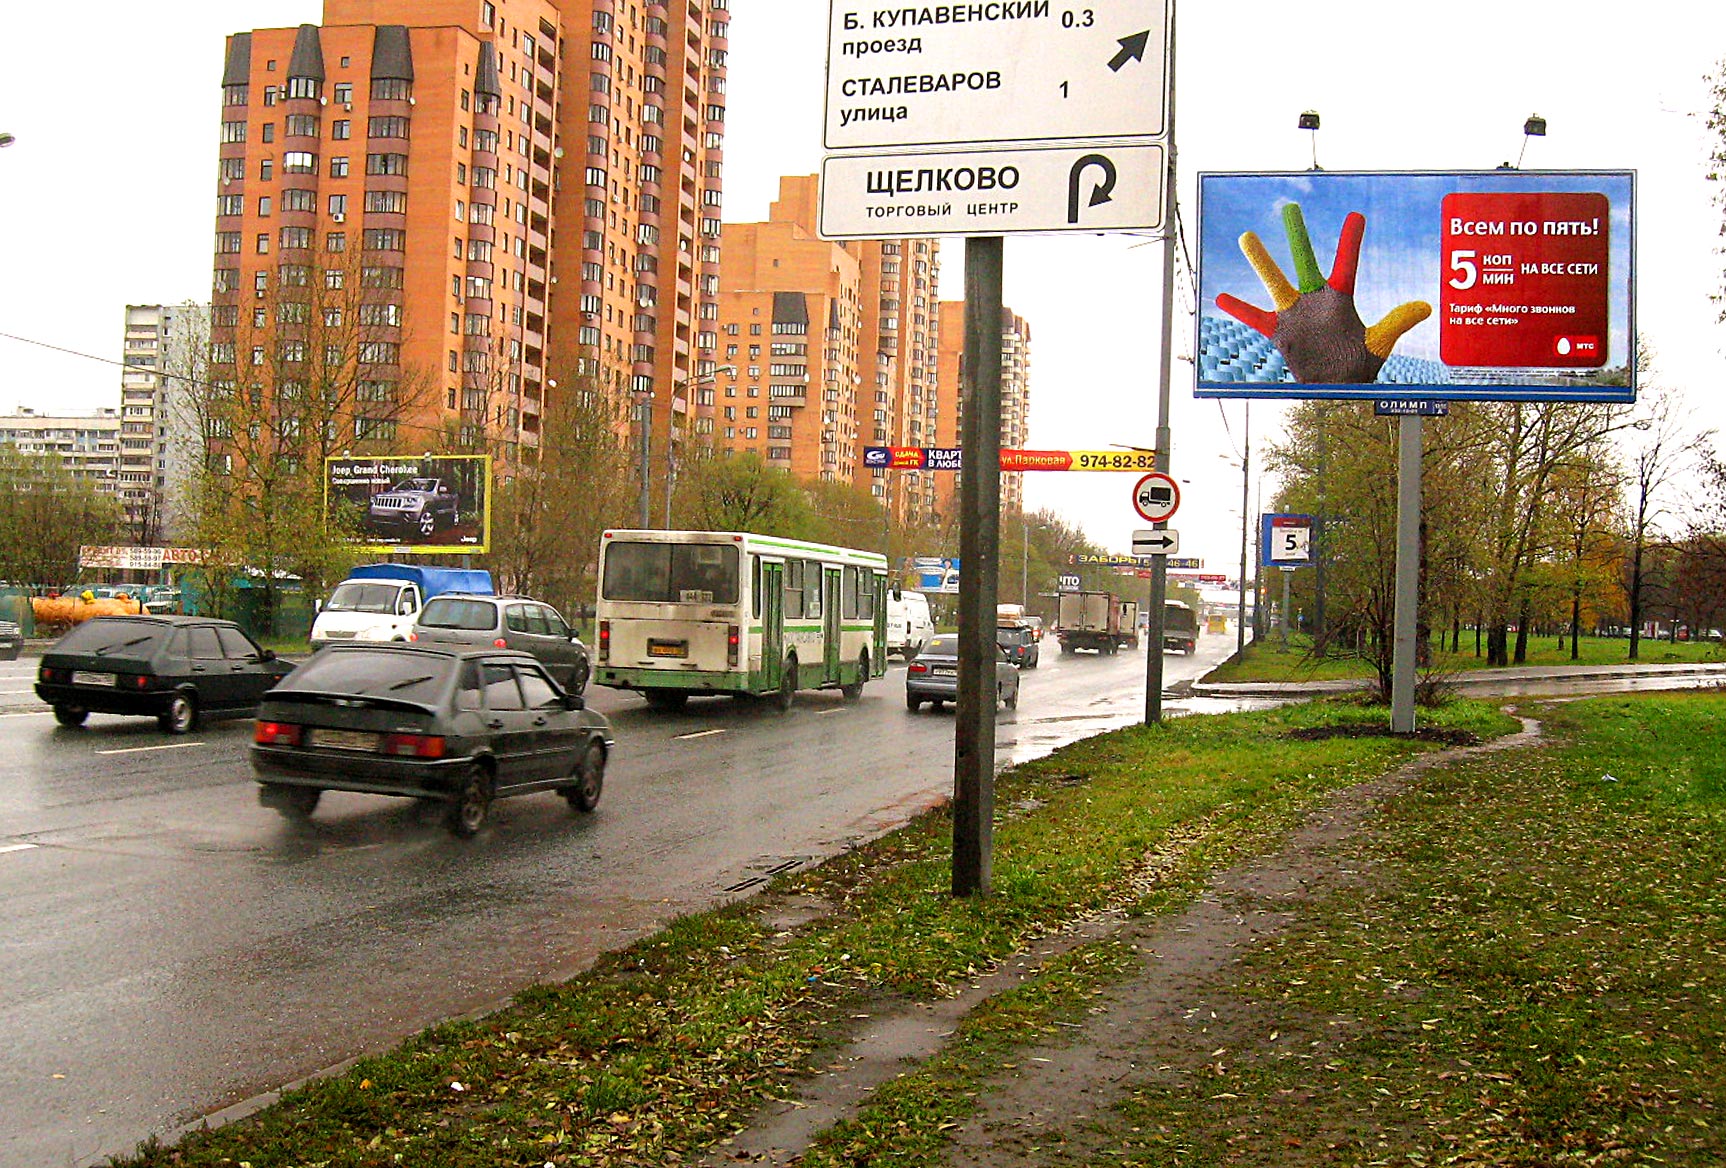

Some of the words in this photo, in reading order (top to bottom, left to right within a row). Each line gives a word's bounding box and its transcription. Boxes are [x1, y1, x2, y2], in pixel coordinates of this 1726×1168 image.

[843, 12, 865, 30] Б.
[1061, 9, 1094, 29] 0.3
[842, 37, 922, 59] проезд
[841, 71, 1001, 97] СТАЛЕВАРОВ
[1060, 80, 1069, 99] 1
[840, 104, 908, 126] улица
[866, 166, 1020, 197] ЩЕЛКОВО
[866, 202, 952, 218] ТОРГОВЫЙ
[966, 202, 1019, 217] ЦЕНТР
[1450, 218, 1504, 236] Всем
[1510, 221, 1537, 236] по
[1543, 218, 1599, 236] пять!
[1448, 250, 1477, 290] 5
[1521, 263, 1539, 275] НА
[1542, 263, 1565, 275] ВСЕ
[1567, 263, 1598, 275] СЕТИ
[1449, 303, 1483, 315] Тариф
[1449, 317, 1462, 325] на
[1465, 317, 1484, 325] все
[1486, 317, 1519, 325] сети»
[1380, 401, 1427, 409] ОЛИМП
[353, 465, 378, 474] Grand
[380, 464, 418, 474] Cherokee
[1080, 454, 1156, 468] 974-82-82
[1285, 534, 1297, 551] 5
[1078, 554, 1141, 565] ЗАБОРЫ
